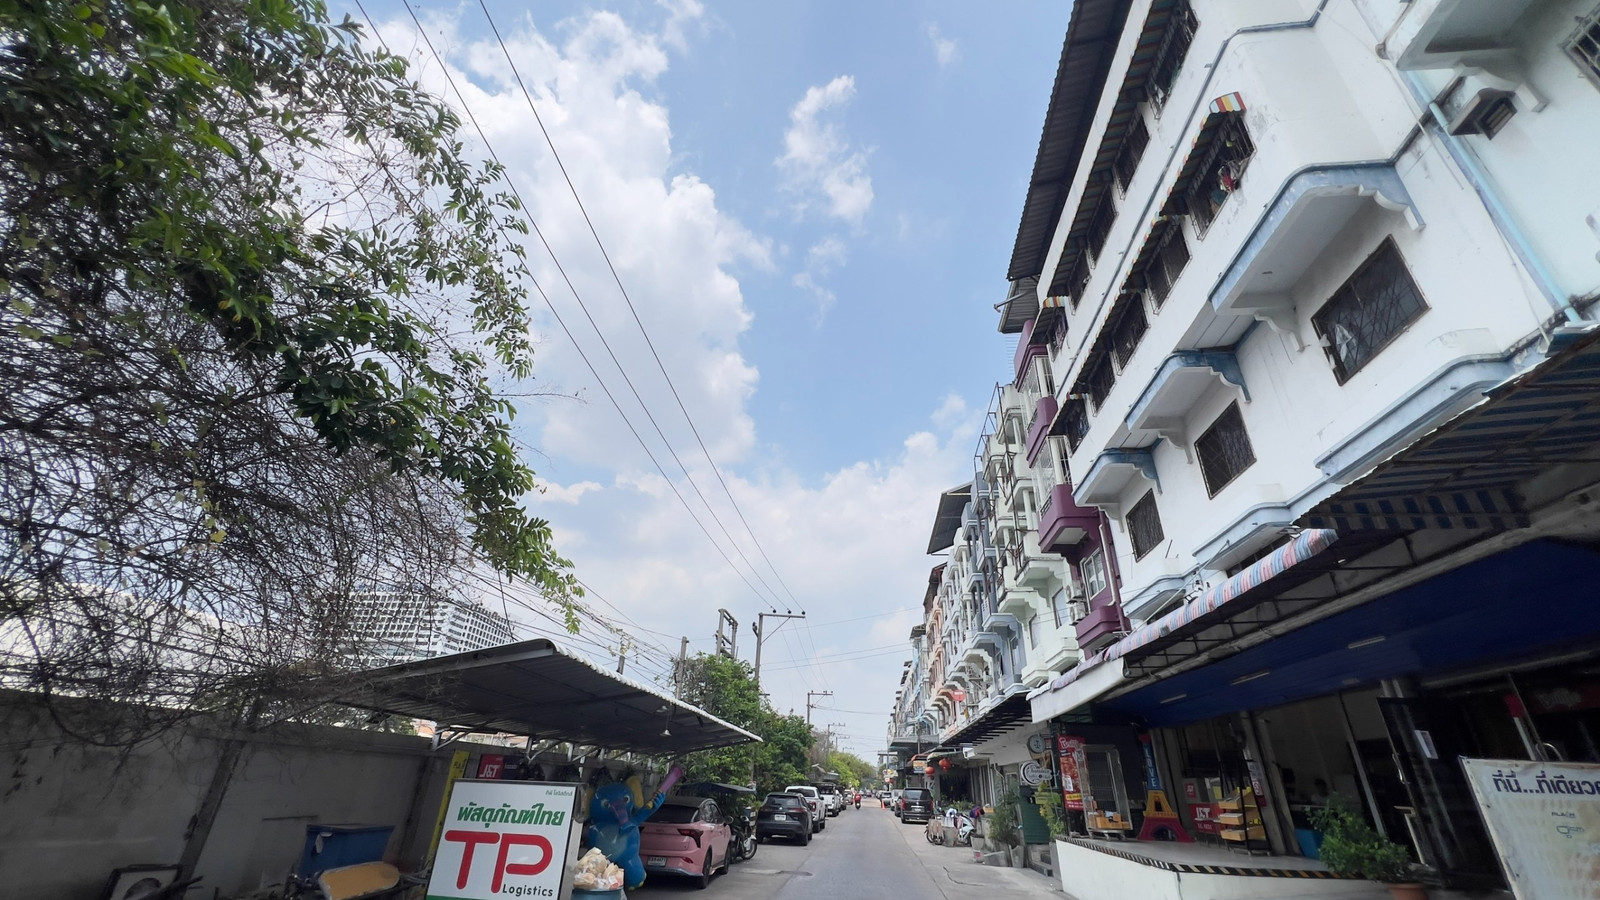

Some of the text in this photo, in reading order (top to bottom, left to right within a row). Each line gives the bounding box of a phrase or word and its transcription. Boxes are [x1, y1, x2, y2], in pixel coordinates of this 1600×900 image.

[479, 764, 501, 778] J&T
[1144, 748, 1157, 787] LOVE
[457, 802, 565, 828] พัสดุภัณฑ์ไทย
[445, 830, 553, 893] TP
[502, 884, 553, 897] Logistics
